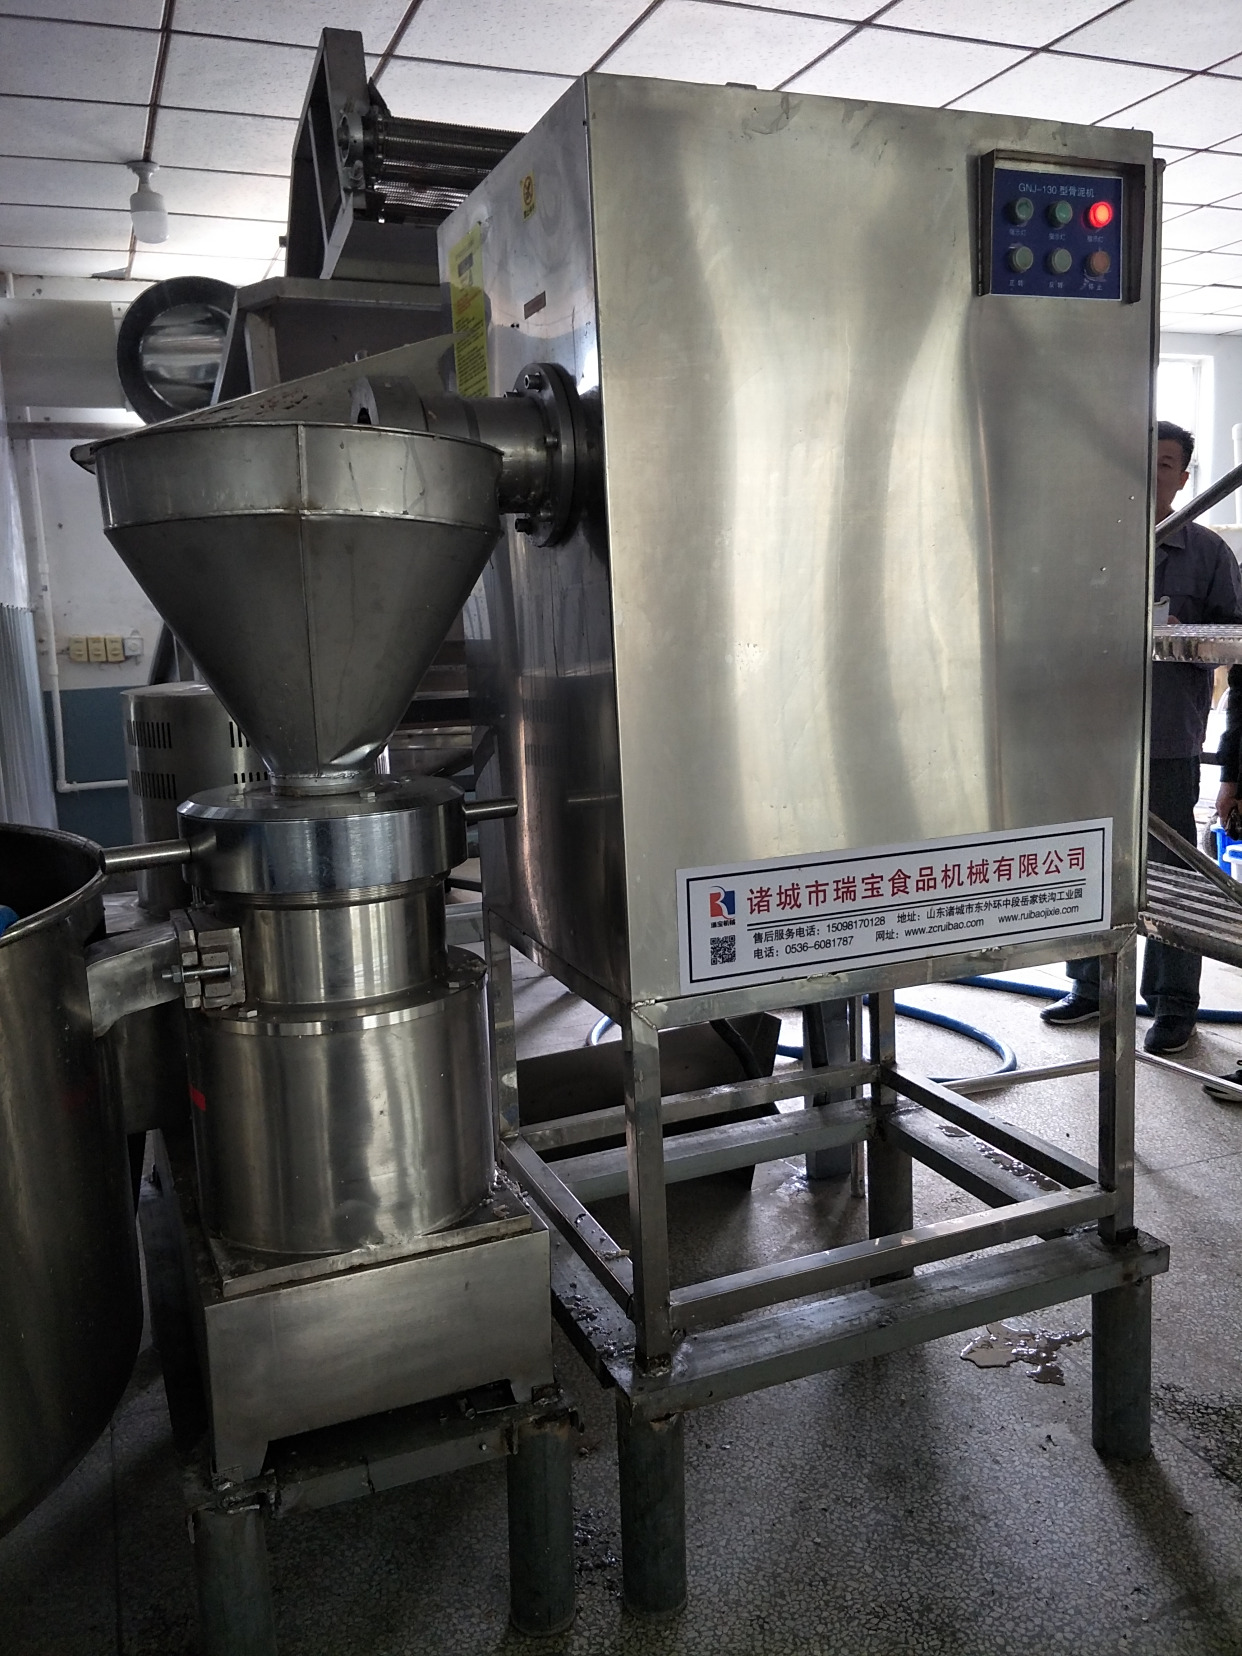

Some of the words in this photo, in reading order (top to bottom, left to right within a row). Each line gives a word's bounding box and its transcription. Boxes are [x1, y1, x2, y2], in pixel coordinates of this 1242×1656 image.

[746, 846, 1086, 916] 诸城市瑞宝食品机械有限公司
[998, 903, 1080, 924] www.ruibaojixie.com
